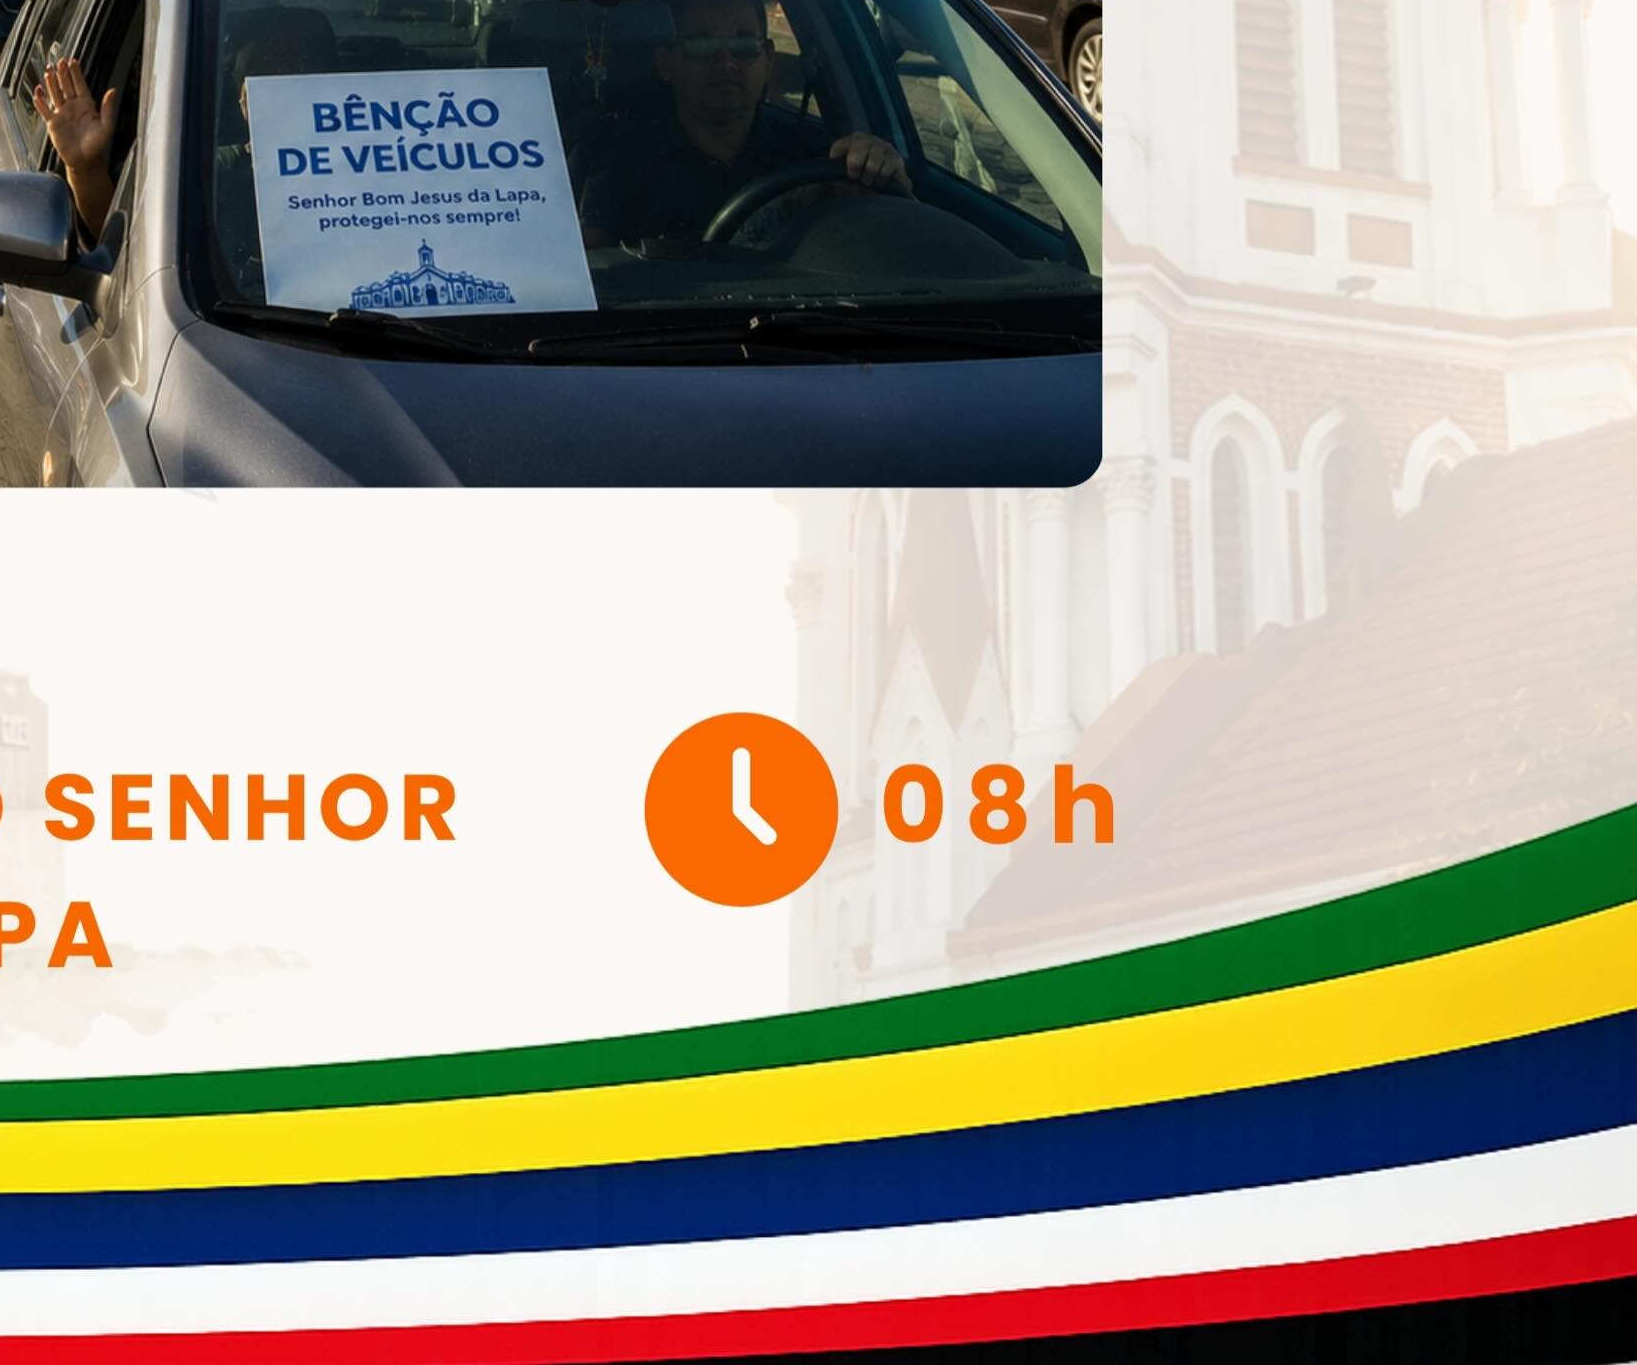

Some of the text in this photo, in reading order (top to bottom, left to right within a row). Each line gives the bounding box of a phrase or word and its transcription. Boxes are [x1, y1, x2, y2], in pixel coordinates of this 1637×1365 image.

[312, 91, 499, 137] BÊNÇÃO
[278, 136, 544, 177] DE VEÍCULOS
[288, 188, 546, 209] Senhor Bom Jesus da Lapa,
[319, 208, 521, 231] protegei-nos sempre!
